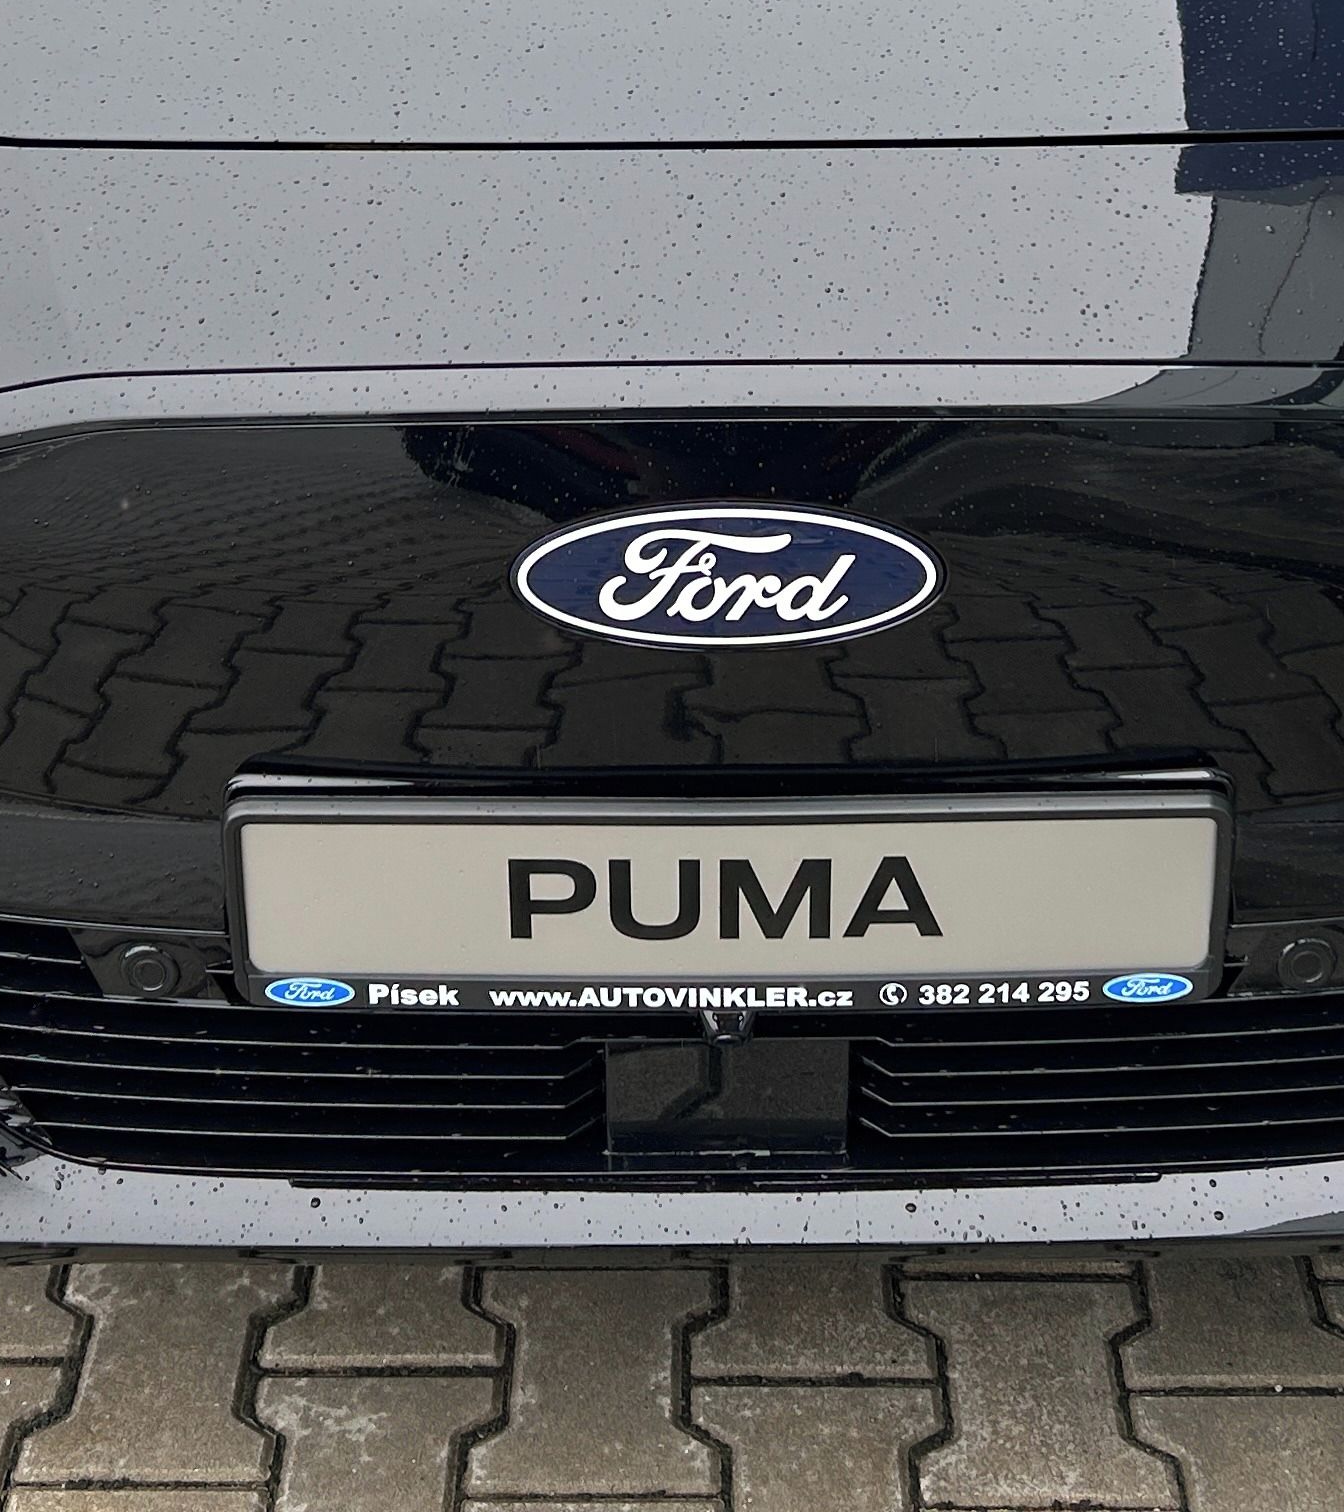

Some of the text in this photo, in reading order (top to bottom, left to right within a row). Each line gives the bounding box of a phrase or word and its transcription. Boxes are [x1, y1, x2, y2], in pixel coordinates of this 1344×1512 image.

[598, 528, 856, 622] Ford
[507, 855, 944, 941] PUMA
[283, 981, 337, 1002] Ford
[368, 981, 1090, 1008] Písek www.AUTOVINKLER.cz 382 214 295
[1120, 977, 1175, 998] Ford
